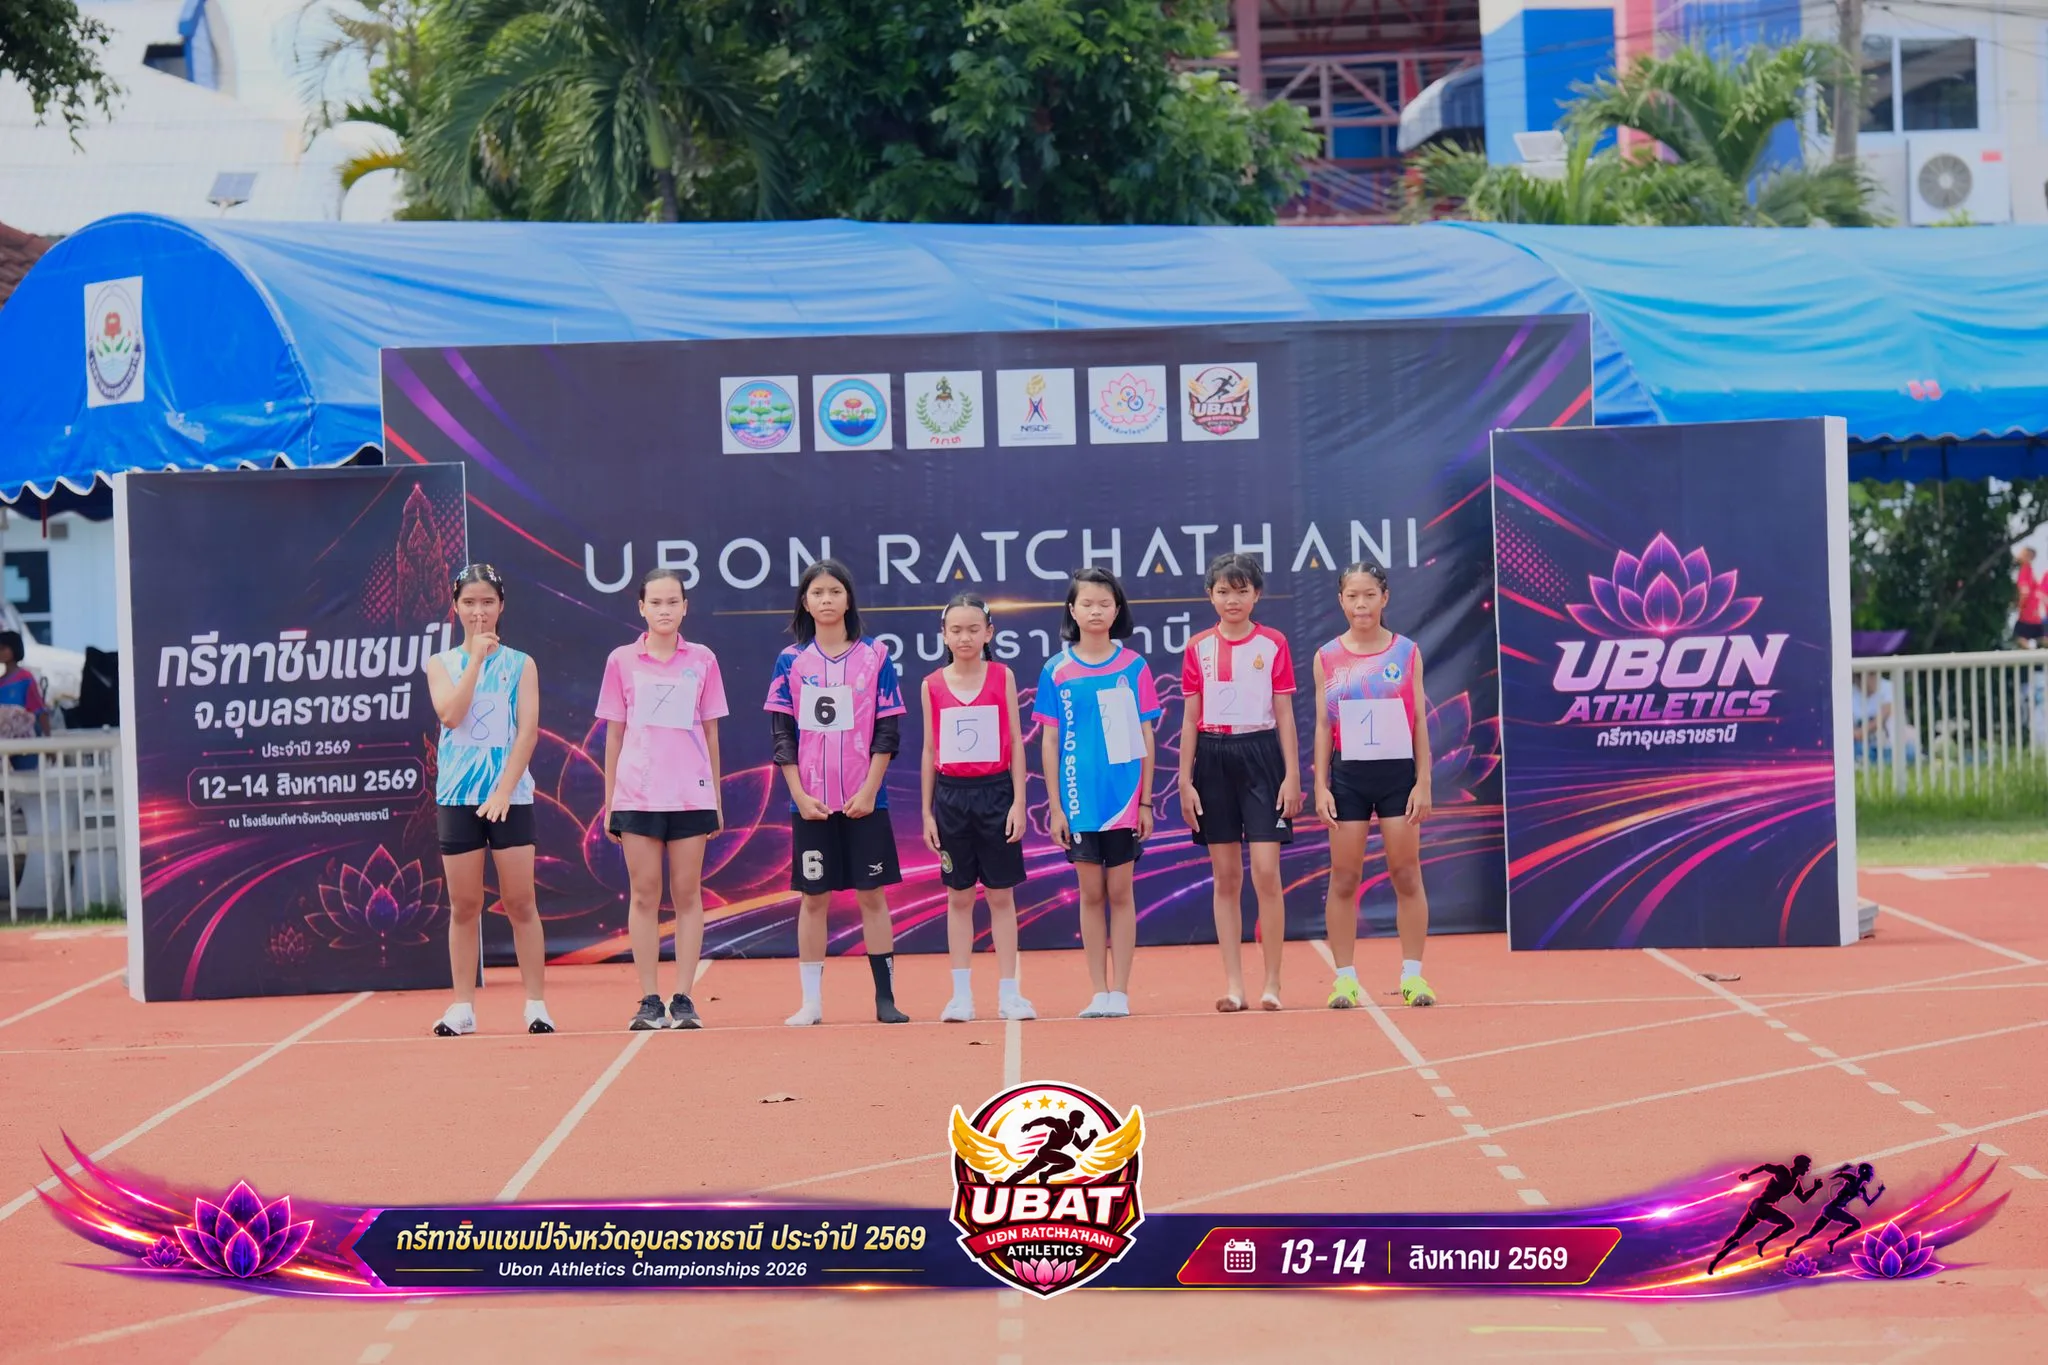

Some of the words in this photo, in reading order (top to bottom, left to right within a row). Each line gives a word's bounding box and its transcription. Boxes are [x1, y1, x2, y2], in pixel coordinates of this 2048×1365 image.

[1194, 402, 1246, 417] UBAT
[585, 534, 831, 593] UBON
[878, 517, 1418, 585] RATCHATHANI
[1552, 633, 1790, 692] UBON
[194, 682, 412, 738] จ.อุบลราชธานี
[651, 684, 676, 716] 7
[814, 695, 837, 725] 6
[1218, 687, 1241, 716] 2
[1560, 690, 1782, 723] ATHLETICS
[470, 699, 496, 741] 8
[955, 718, 979, 752] 5
[1060, 689, 1076, 752] SAOLAO
[1360, 708, 1382, 746] 1
[261, 740, 311, 758] ประจำปี
[315, 740, 351, 756] 2569
[1596, 723, 1738, 751] กรีฑาอุบลราชธานี
[276, 772, 356, 796] สิงหาคม
[363, 768, 418, 792] 2569
[1065, 755, 1081, 820] SCHOOL
[802, 850, 824, 880] 6
